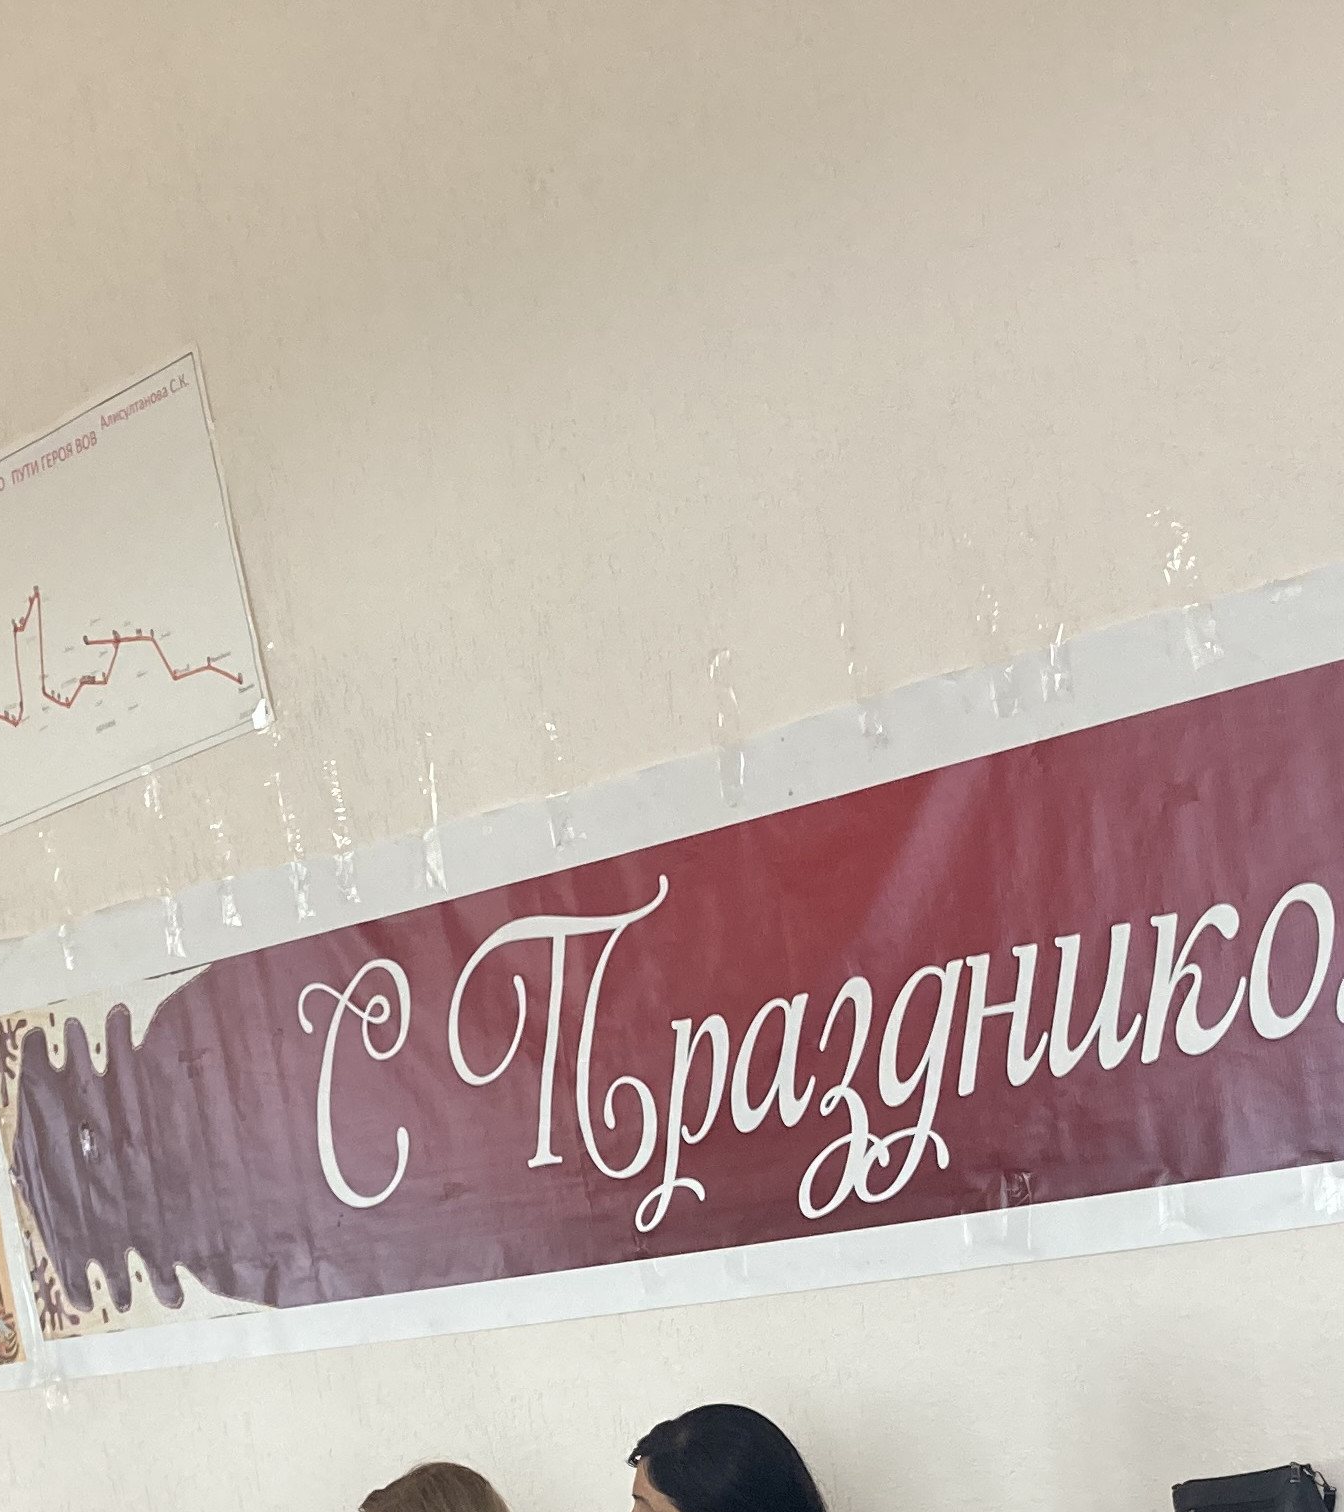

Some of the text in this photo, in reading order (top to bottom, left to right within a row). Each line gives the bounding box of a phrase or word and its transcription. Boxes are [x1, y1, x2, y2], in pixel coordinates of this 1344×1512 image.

[11, 459, 39, 485] ПУТИ
[41, 442, 73, 471] ГЕРОЯ
[75, 430, 98, 454] ВОВ
[296, 957, 410, 1209] С
